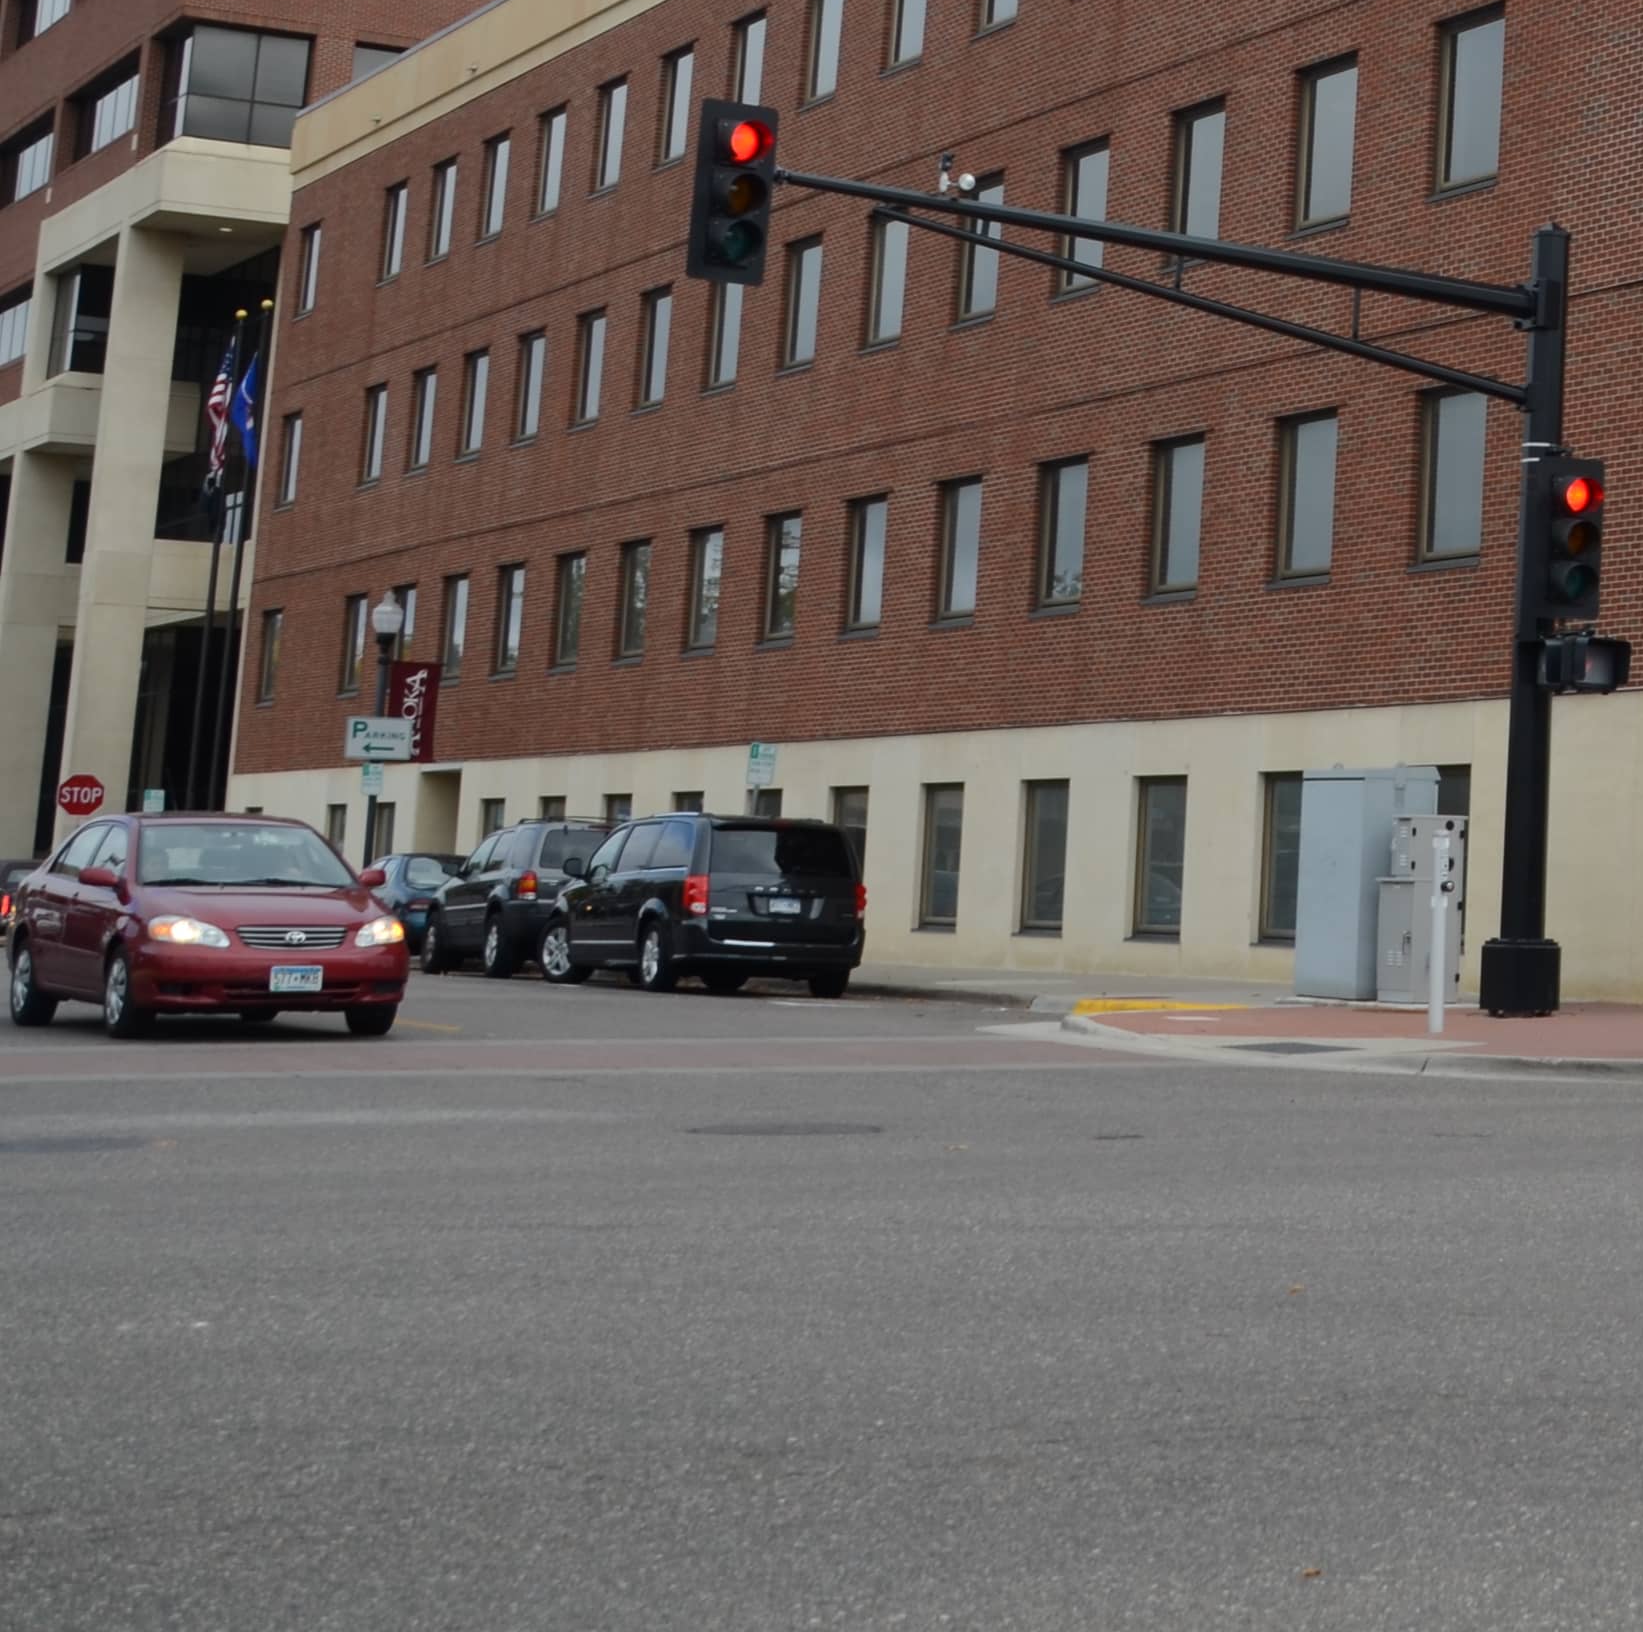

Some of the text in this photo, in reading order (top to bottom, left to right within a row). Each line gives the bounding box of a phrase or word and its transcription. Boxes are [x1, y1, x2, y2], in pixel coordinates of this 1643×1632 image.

[402, 669, 428, 756] OKA
[352, 721, 406, 741] PARKING
[60, 787, 103, 804] STOP
